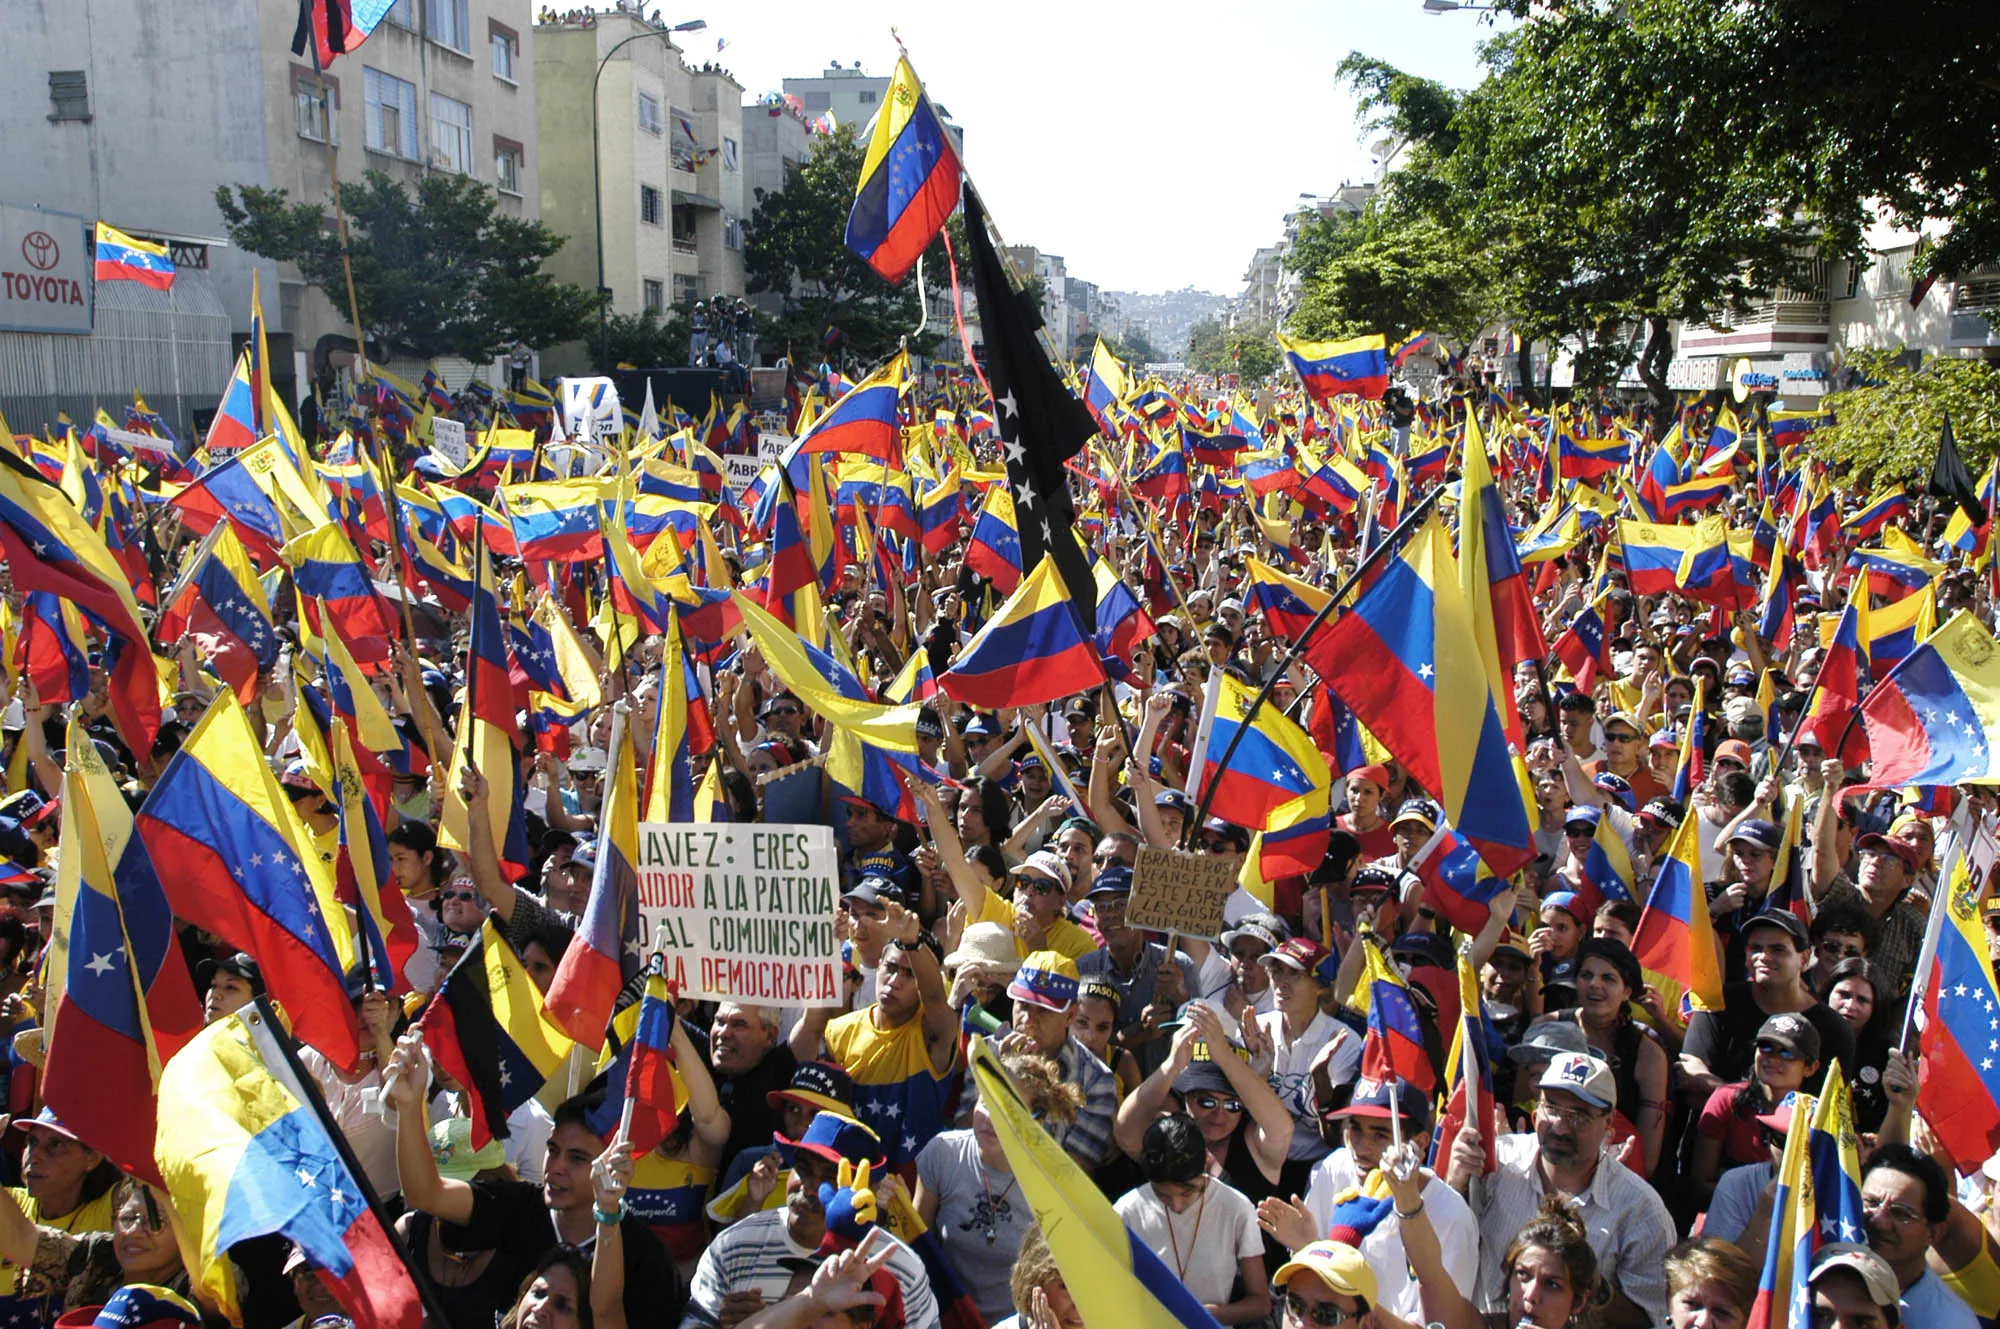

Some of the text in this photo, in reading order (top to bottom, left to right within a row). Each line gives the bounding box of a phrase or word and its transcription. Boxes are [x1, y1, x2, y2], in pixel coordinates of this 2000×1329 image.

[2, 271, 84, 306] TOYOTA
[752, 832, 809, 871] ERES
[703, 873, 718, 910] A
[723, 874, 749, 912] LA
[754, 876, 834, 915] PATRIA
[1204, 876, 1227, 889] EN
[661, 917, 694, 949] AL
[709, 916, 834, 957] COMUNISMO
[701, 957, 838, 1001] DEMOCRACIA
[1089, 984, 1112, 998] PASO
